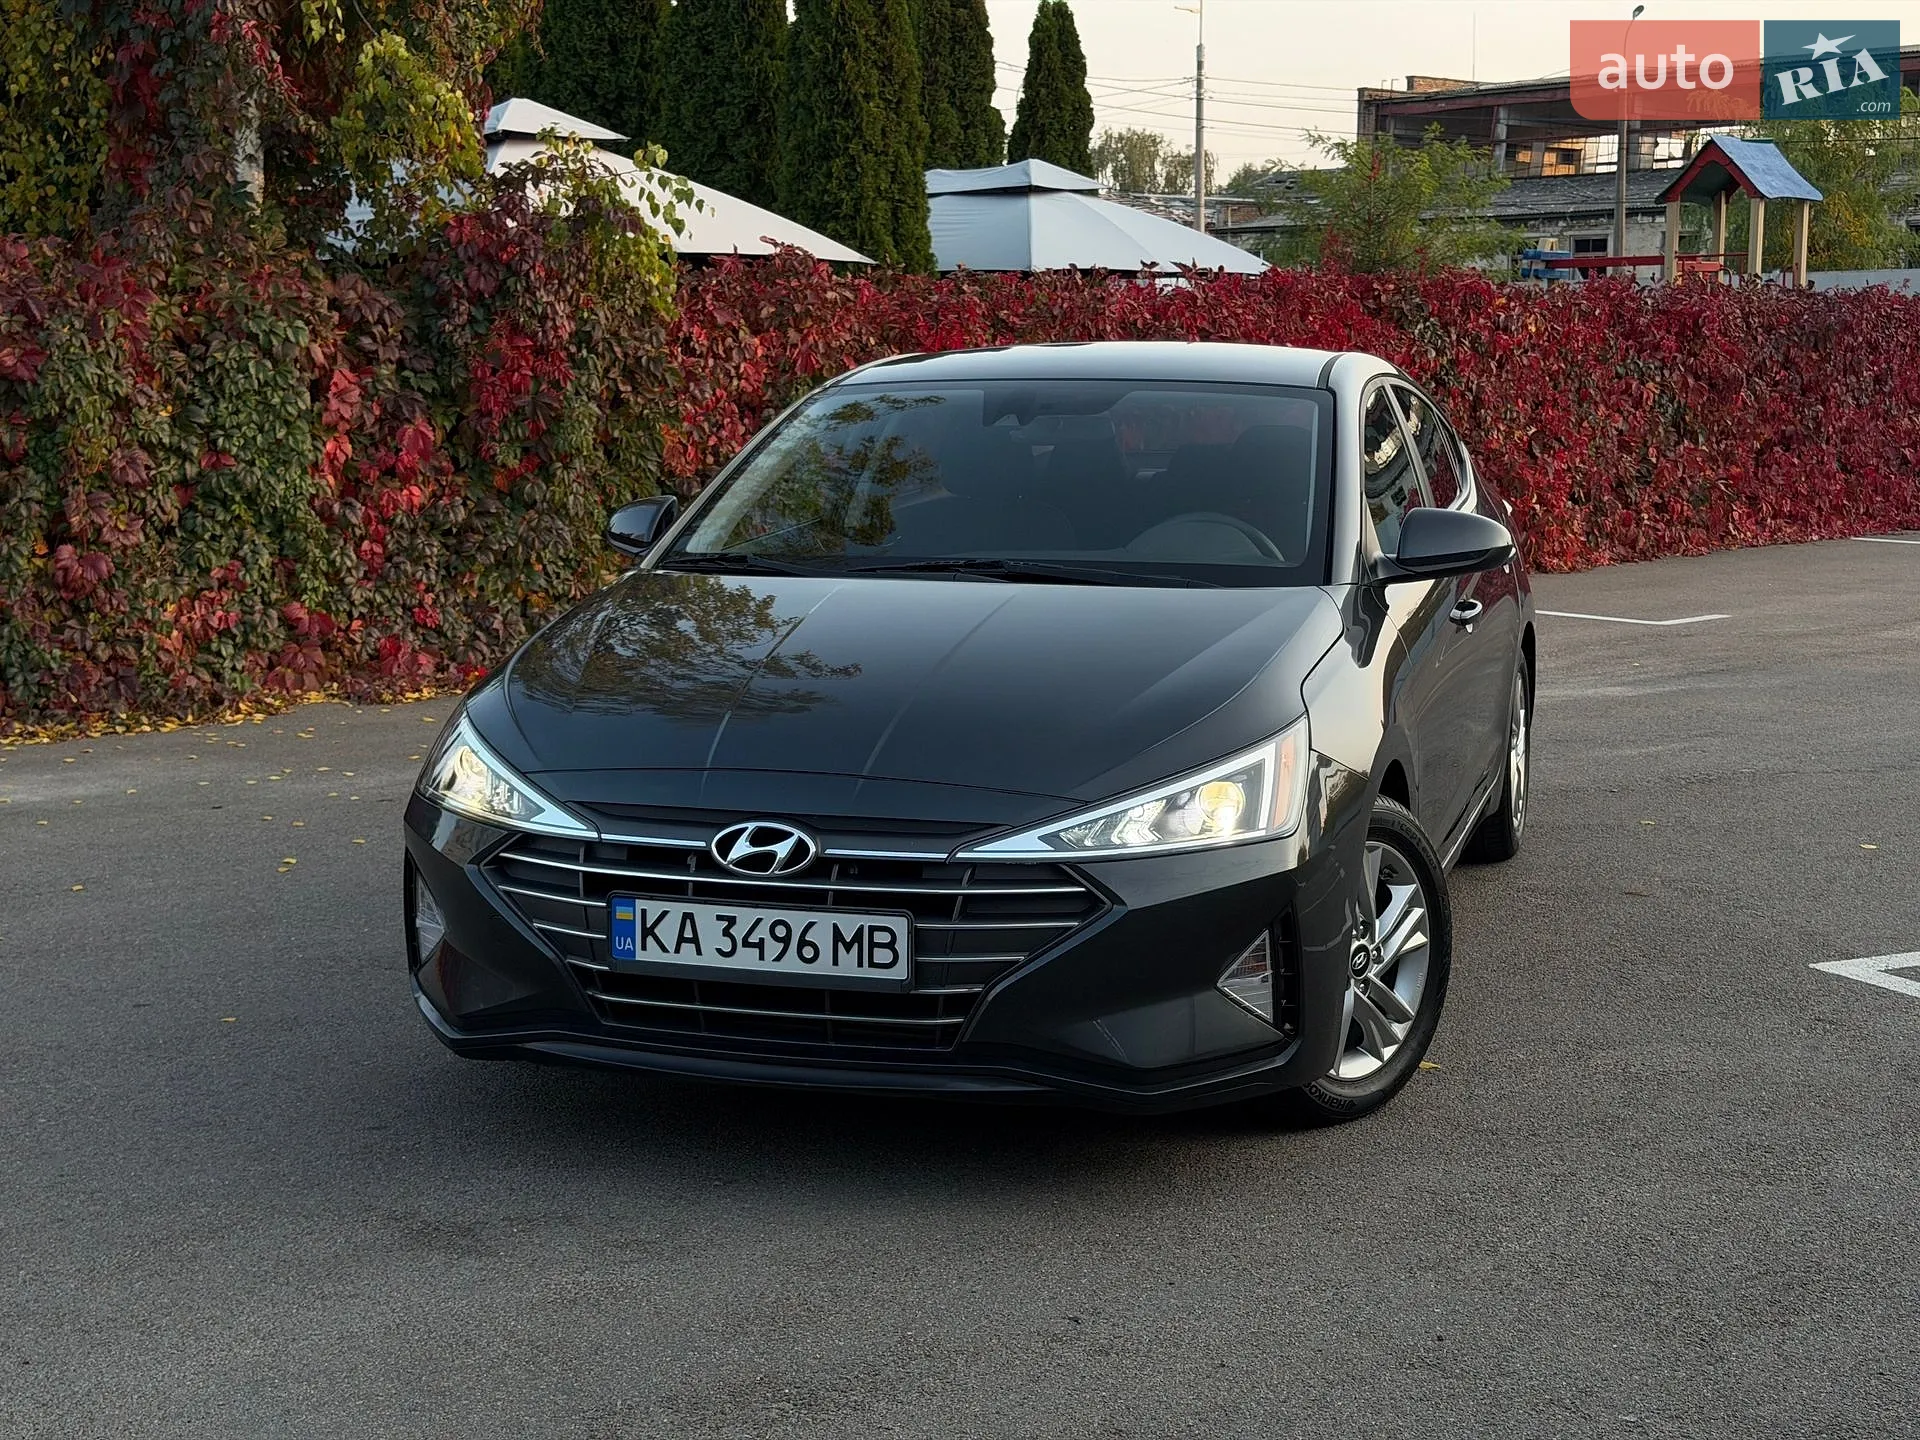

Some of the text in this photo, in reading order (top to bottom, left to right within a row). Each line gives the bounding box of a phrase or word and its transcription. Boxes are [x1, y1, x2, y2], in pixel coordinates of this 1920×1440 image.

[615, 936, 634, 951] UA
[640, 907, 900, 970] KA 3496 MB
